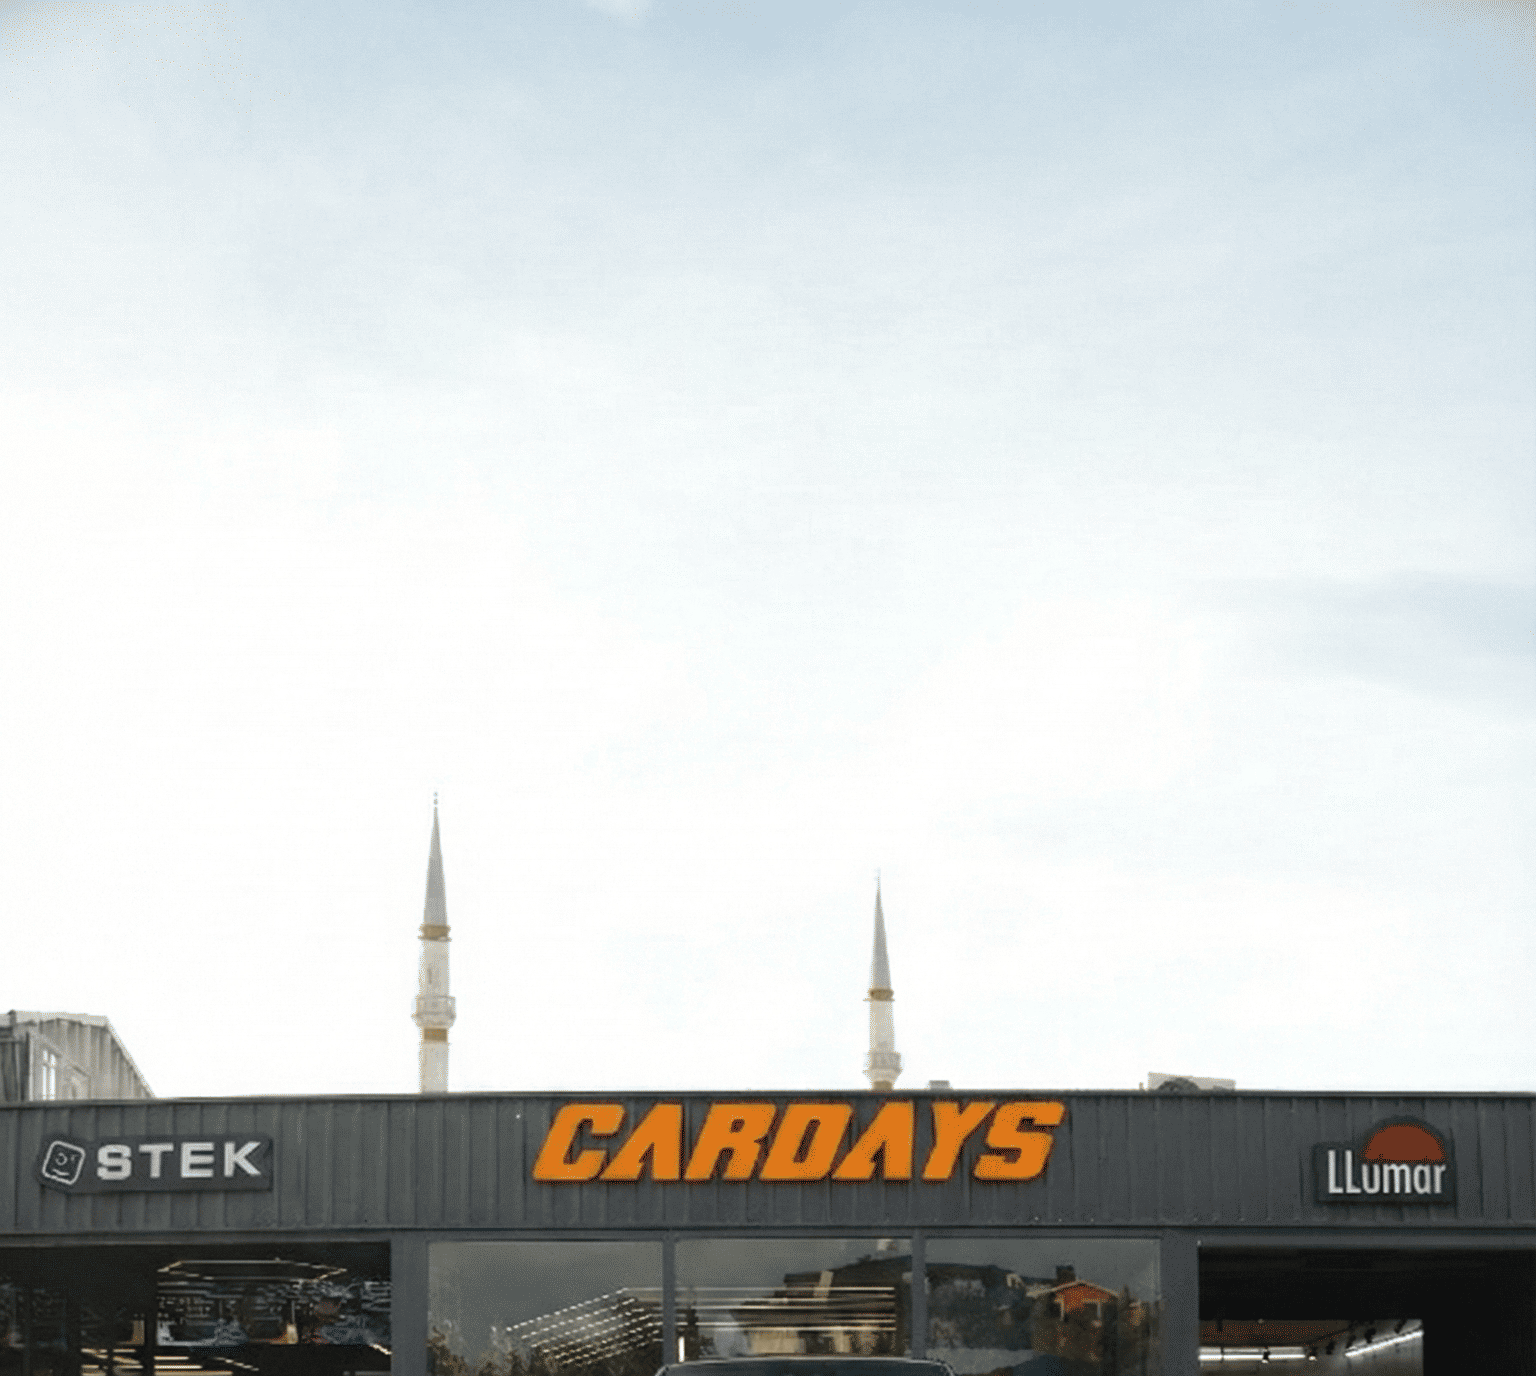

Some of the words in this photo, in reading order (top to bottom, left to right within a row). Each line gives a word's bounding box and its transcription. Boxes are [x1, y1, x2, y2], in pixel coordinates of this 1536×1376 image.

[97, 1141, 261, 1180] STEK
[532, 1101, 1066, 1180] CARDAYS
[1328, 1149, 1446, 1194] LLumar
